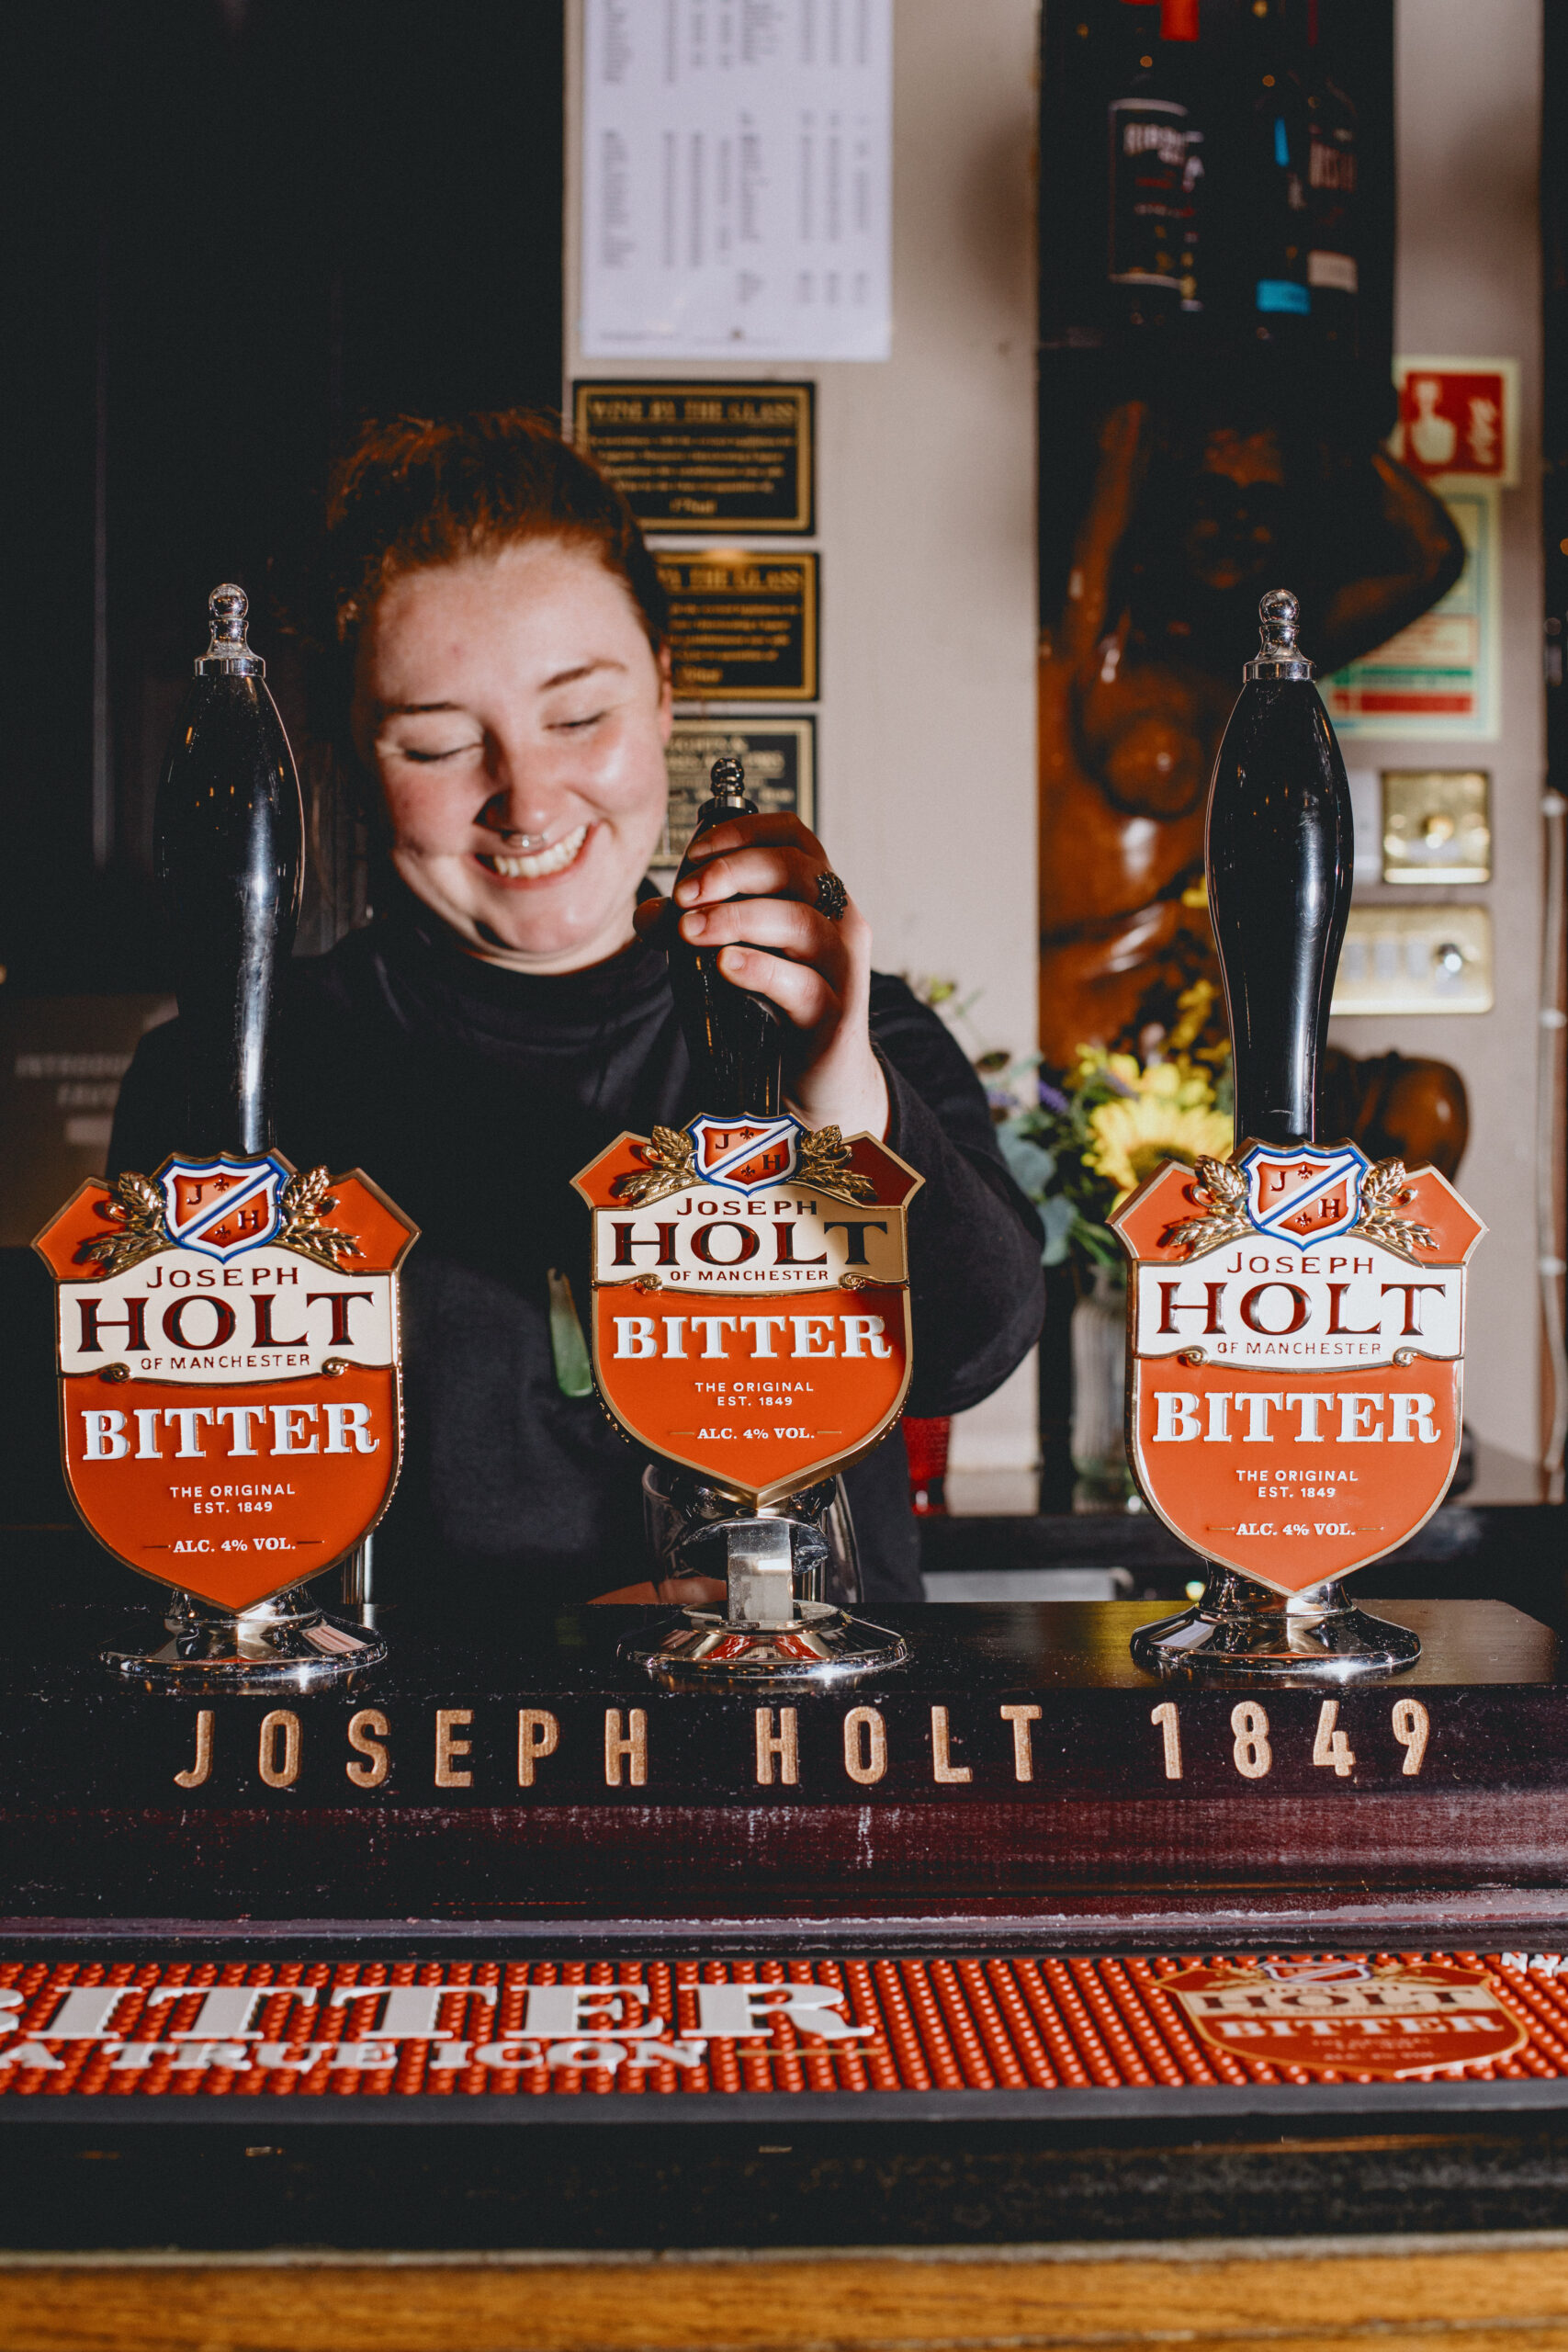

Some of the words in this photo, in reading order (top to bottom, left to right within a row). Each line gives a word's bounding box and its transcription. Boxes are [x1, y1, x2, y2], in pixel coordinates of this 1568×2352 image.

[676, 1197, 818, 1216] JOSEPH
[610, 1220, 888, 1266] HOLT
[1226, 1251, 1374, 1274] JOSEPH
[146, 1266, 299, 1289] JOSEPH
[671, 1270, 692, 1282] OF
[698, 1269, 829, 1282] MANCHESTER
[1156, 1281, 1447, 1337] HOLT
[76, 1291, 375, 1352] HOLT
[613, 1314, 892, 1360] BITTER
[1216, 1341, 1239, 1354] OF
[1246, 1341, 1382, 1355] MANCHESTER
[141, 1357, 163, 1370] OF
[170, 1353, 310, 1369] MANCHESTER
[695, 1382, 727, 1393] THE
[733, 1381, 814, 1393] ORIGINAL
[716, 1396, 752, 1407] EST.
[758, 1396, 793, 1407] 1849
[1153, 1391, 1441, 1443] BITTER
[81, 1401, 380, 1461] BITTER
[697, 1427, 738, 1440] ALC.
[742, 1428, 769, 1440] 4%
[773, 1427, 815, 1440] VOL.
[1236, 1469, 1269, 1482] THE
[1274, 1469, 1359, 1482] ORIGINAL
[170, 1486, 203, 1498] THE
[209, 1483, 296, 1497] ORIGINAL
[1258, 1486, 1293, 1498] EST.
[1300, 1486, 1337, 1498] 1849
[193, 1501, 230, 1514] EST.
[237, 1500, 273, 1513] 1849
[1236, 1522, 1278, 1537] ALC.
[1282, 1522, 1310, 1537] 4%
[1314, 1522, 1357, 1537] VOL.
[173, 1538, 216, 1554] ALC.
[220, 1538, 248, 1553] 4%
[253, 1536, 297, 1551] VOL.
[173, 1706, 649, 1789] JOSEPH
[754, 1703, 1043, 1785] HOLT
[1150, 1697, 1430, 1781] 1849
[1201, 1990, 1476, 2009] HOLT
[0, 1984, 875, 2039] ITTER
[1215, 2015, 1505, 2039] BITTER
[104, 2041, 398, 2073] TRUE
[429, 2041, 707, 2074] ICON
